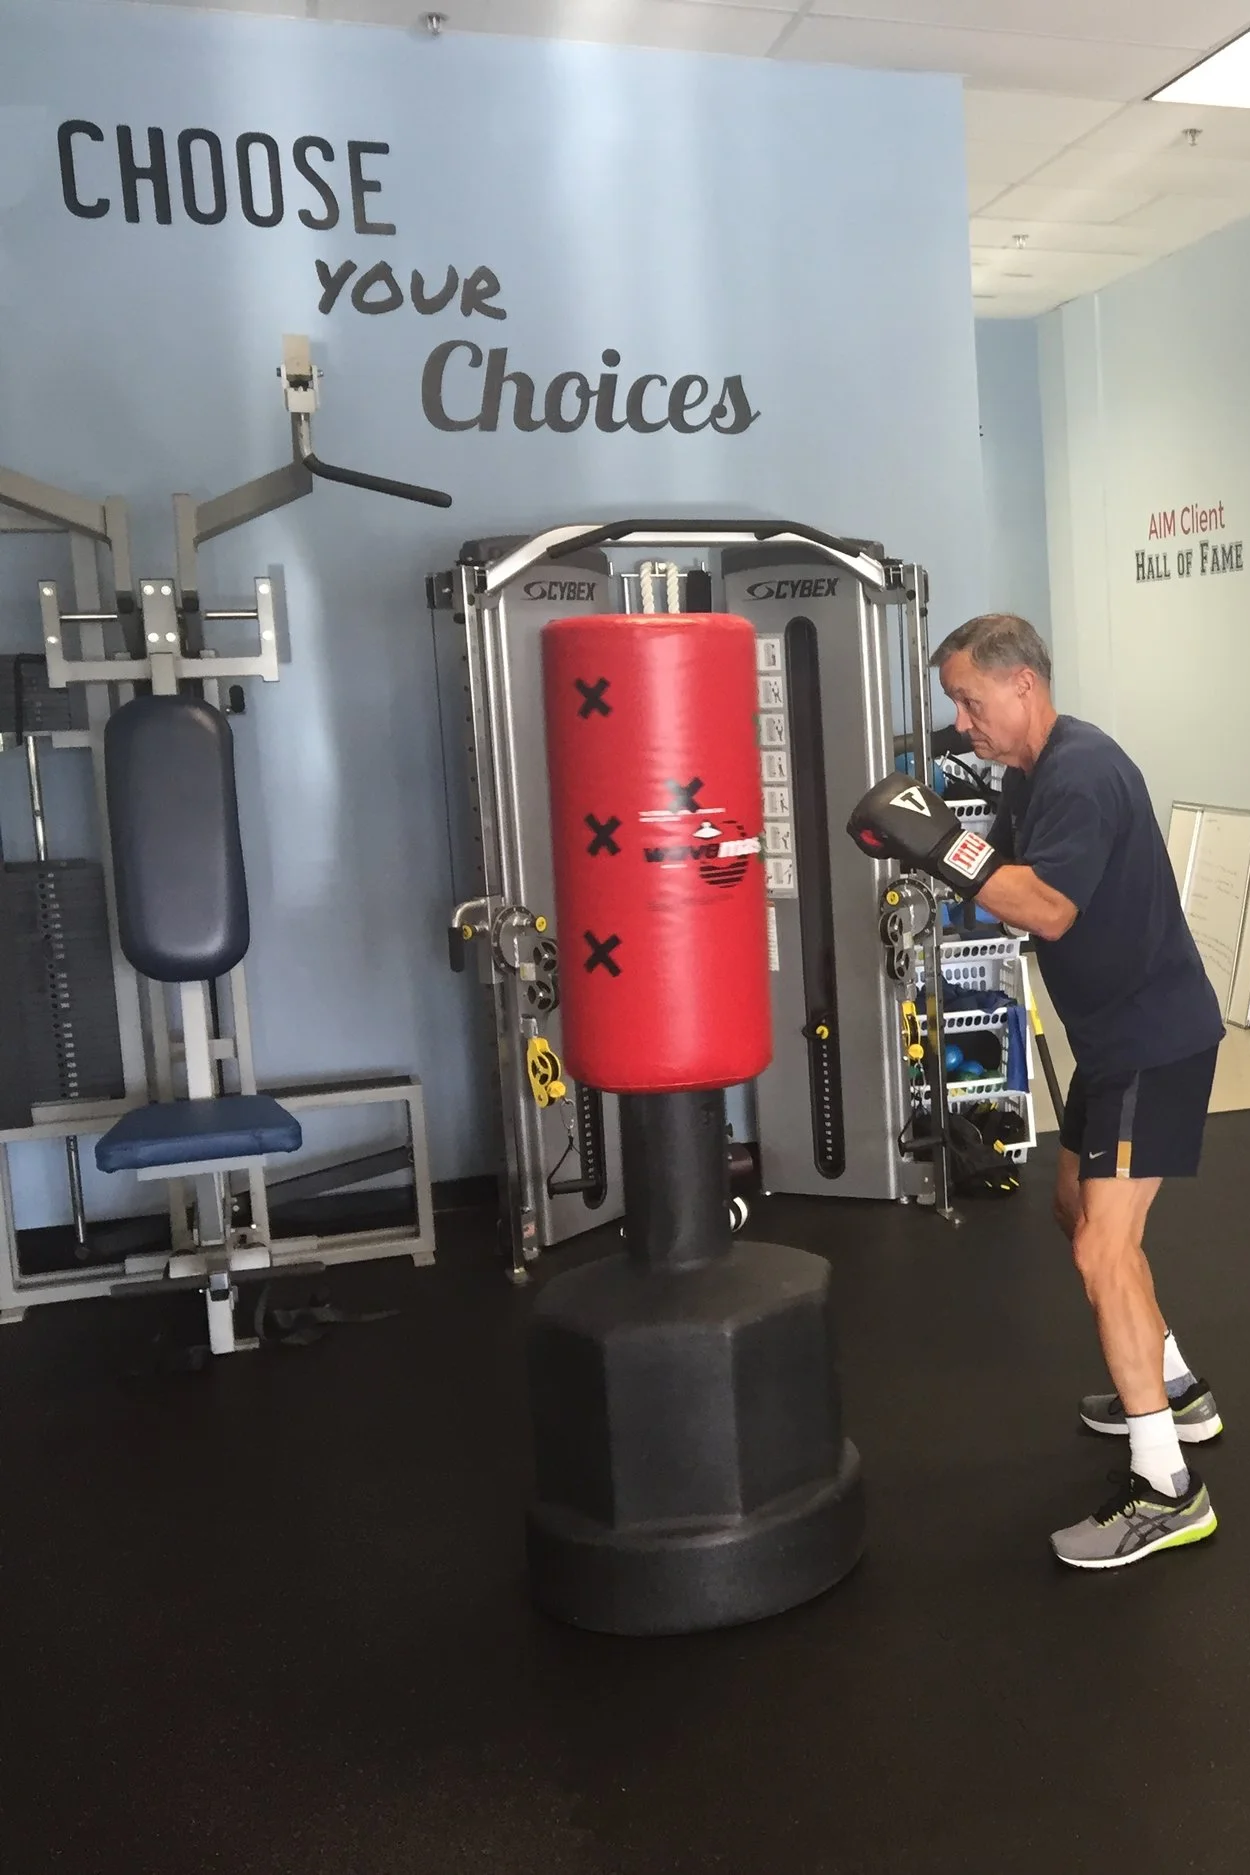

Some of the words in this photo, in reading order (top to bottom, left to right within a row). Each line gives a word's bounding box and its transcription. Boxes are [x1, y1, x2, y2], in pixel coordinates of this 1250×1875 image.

[57, 119, 397, 236] CHOOSE
[315, 259, 507, 320] YOUR
[421, 339, 762, 435] Choices
[1148, 509, 1176, 540] AIM
[1180, 500, 1226, 535] Client
[547, 581, 597, 601] CYBEX
[774, 577, 839, 599] CYBEX
[952, 834, 987, 869] TITLE
